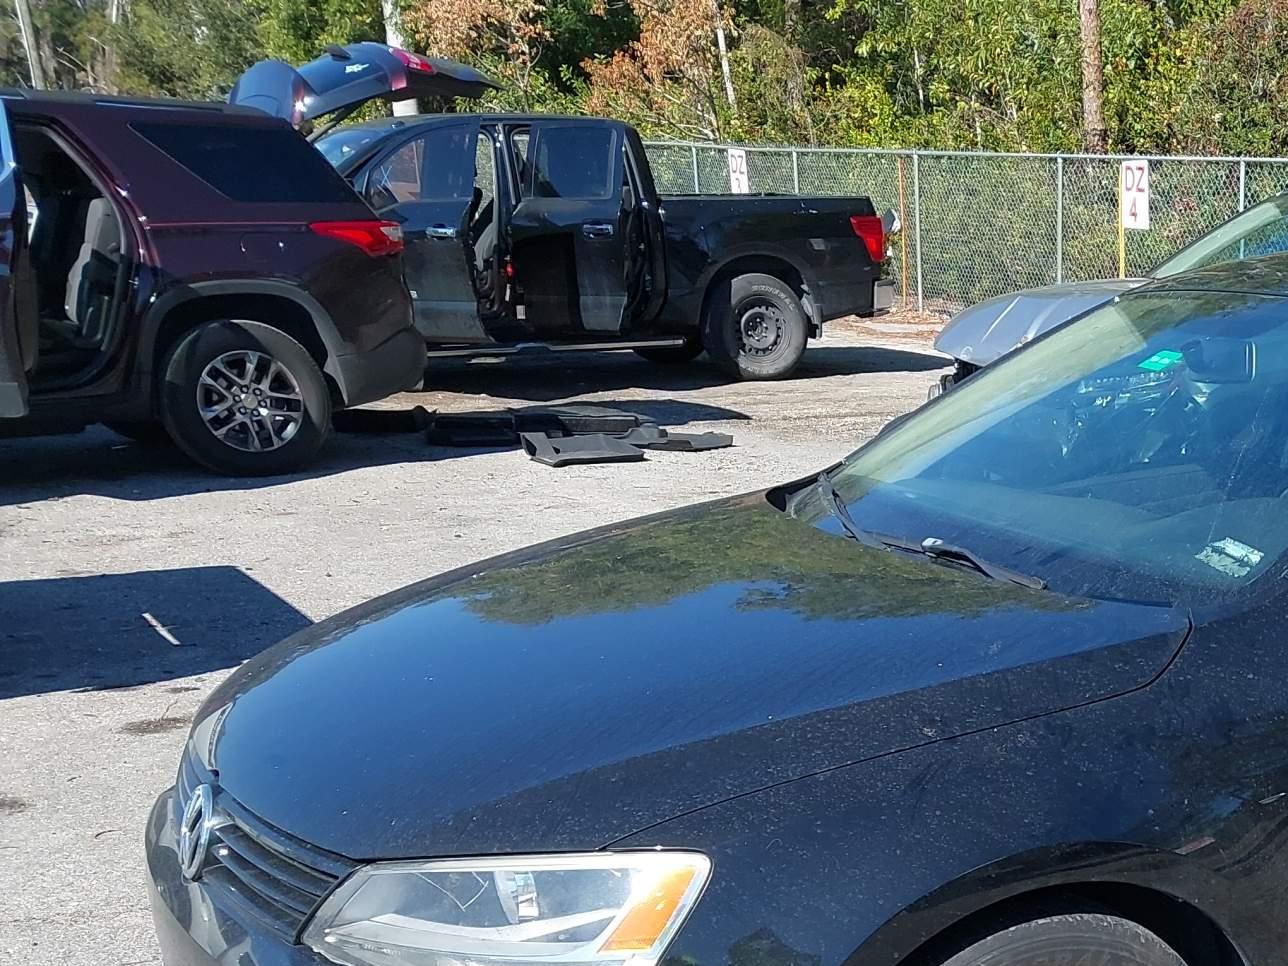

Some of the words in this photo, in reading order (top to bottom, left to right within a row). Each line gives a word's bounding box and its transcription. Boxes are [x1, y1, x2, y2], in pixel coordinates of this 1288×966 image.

[730, 154, 745, 175] DZ
[1125, 165, 1146, 192] DZ
[1129, 196, 1138, 223] 4
